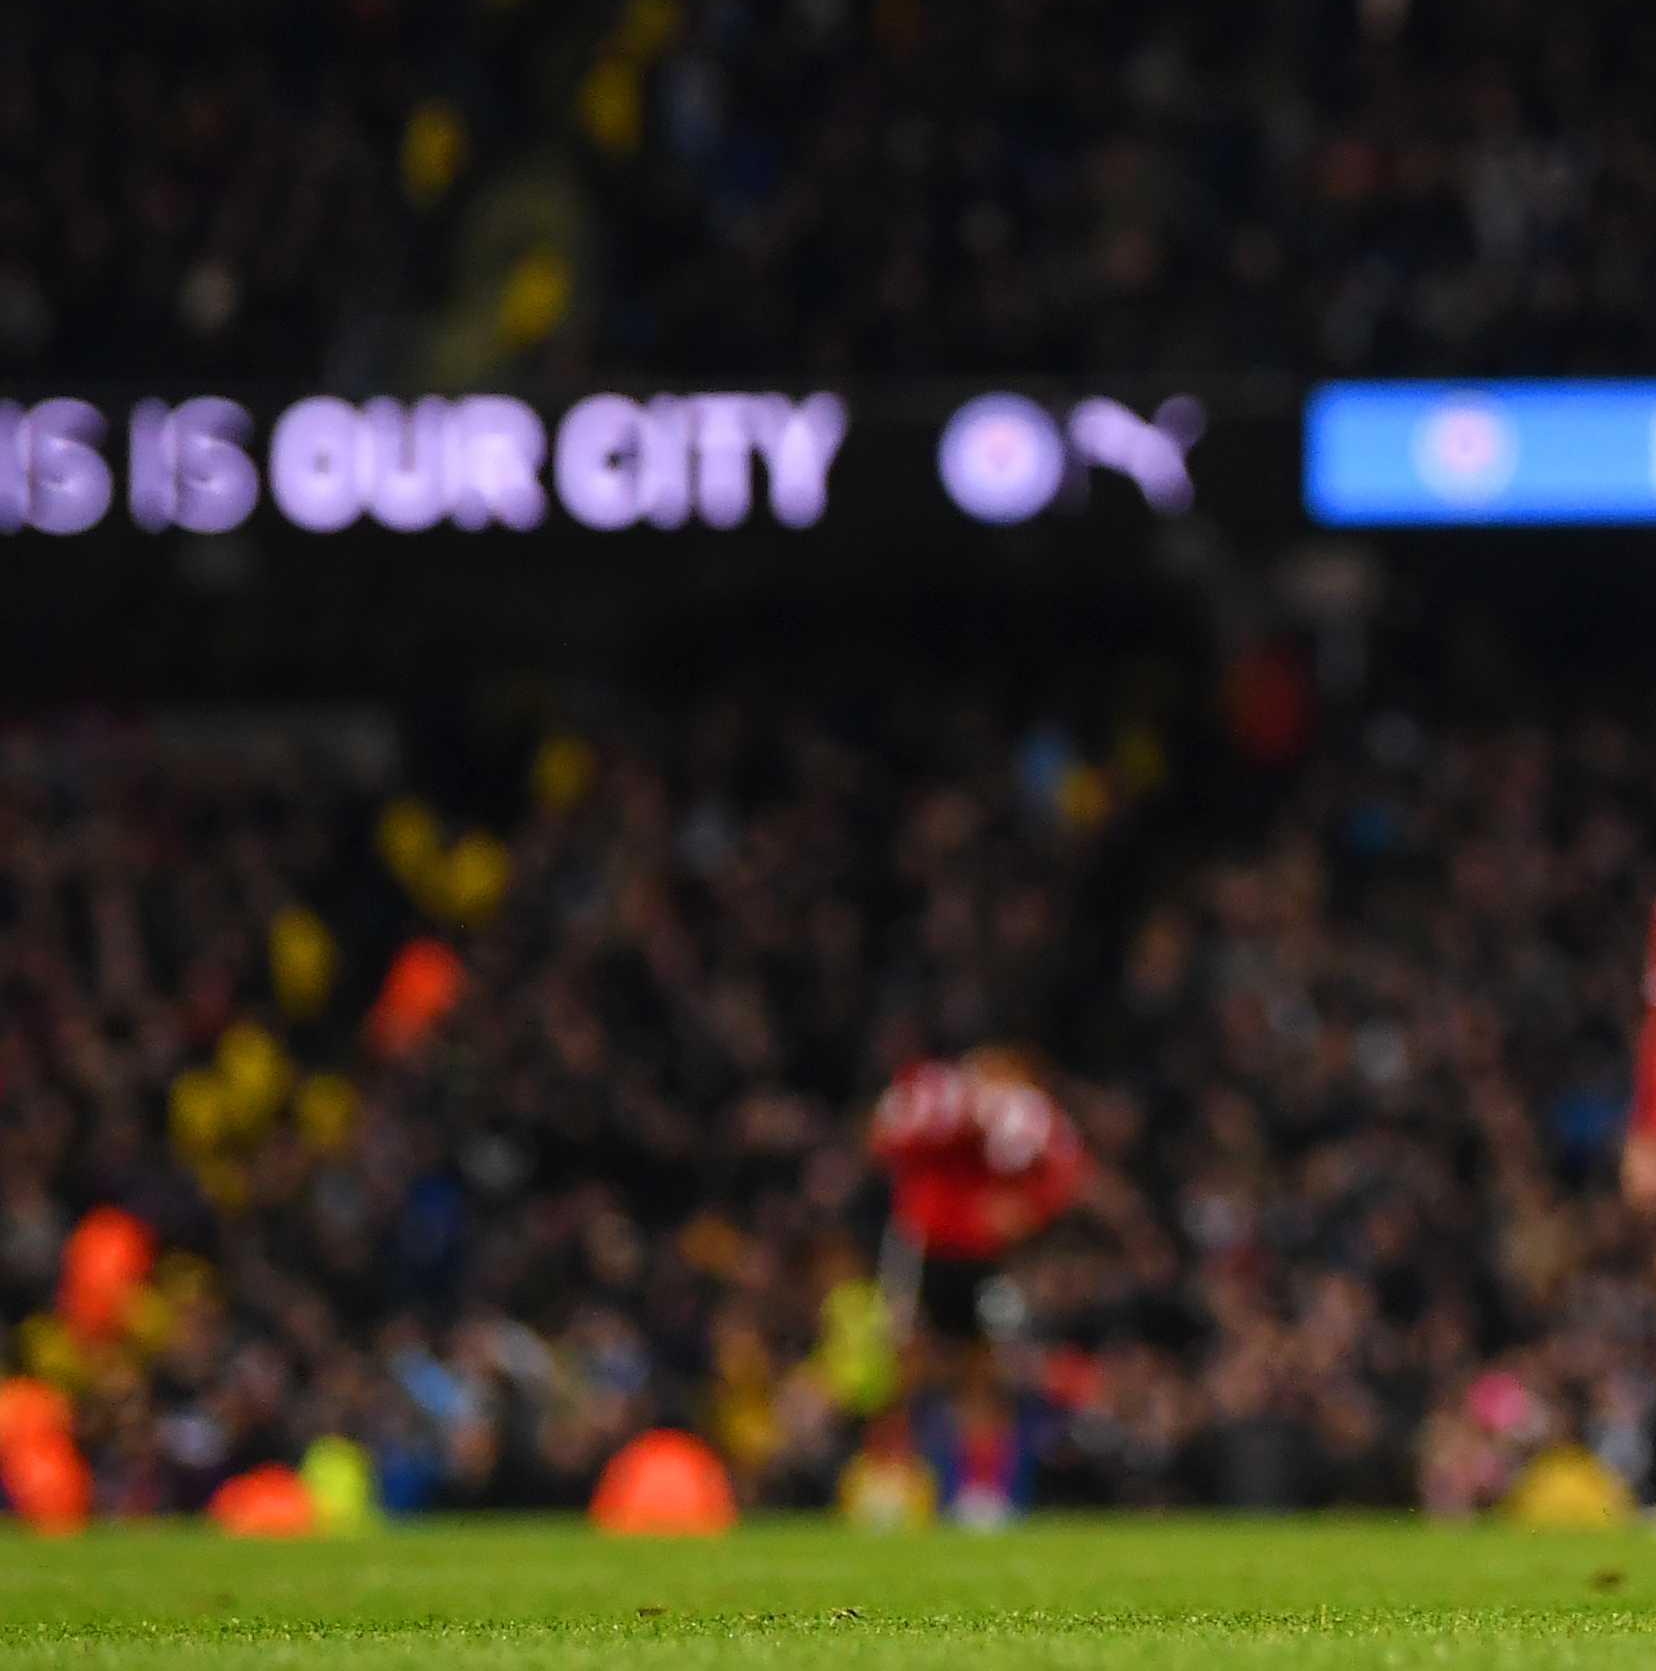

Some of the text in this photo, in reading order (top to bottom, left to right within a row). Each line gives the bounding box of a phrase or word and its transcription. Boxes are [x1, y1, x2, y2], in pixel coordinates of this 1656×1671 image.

[128, 395, 259, 535] IS
[271, 394, 546, 532] OUR
[557, 392, 847, 530] CITY
